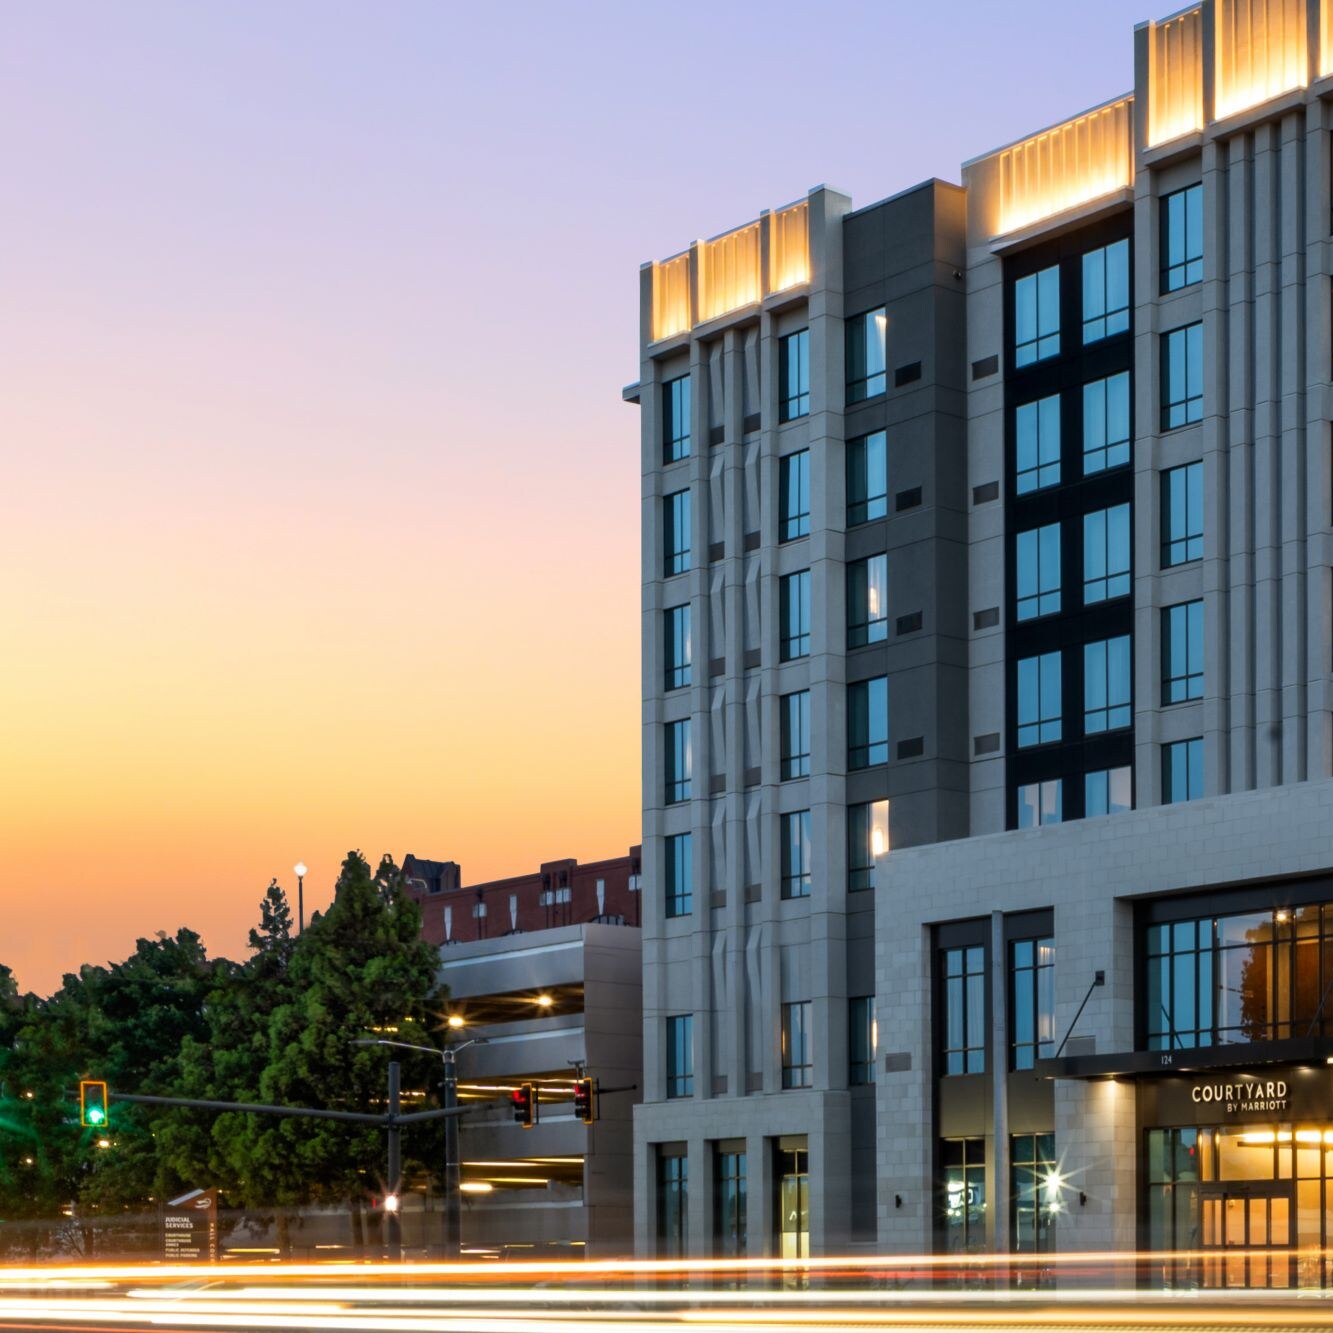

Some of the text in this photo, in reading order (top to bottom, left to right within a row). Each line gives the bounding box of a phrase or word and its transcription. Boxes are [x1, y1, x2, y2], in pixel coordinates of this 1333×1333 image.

[1161, 1055, 1172, 1065] 124
[1191, 1080, 1287, 1103] COURTYARD
[1227, 1100, 1287, 1113] BY MARRIOTT
